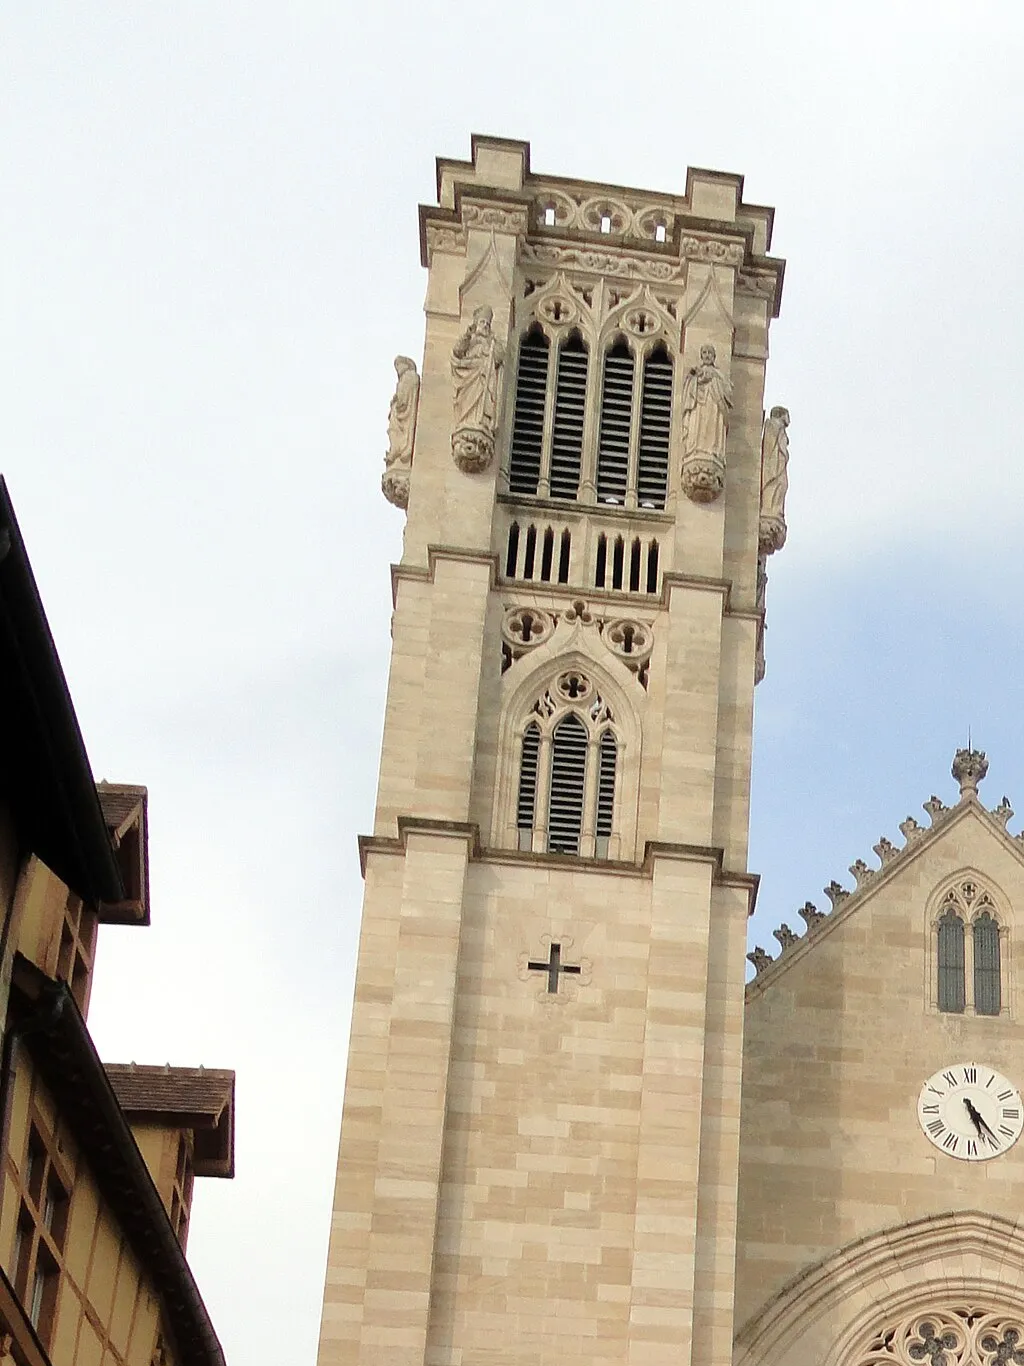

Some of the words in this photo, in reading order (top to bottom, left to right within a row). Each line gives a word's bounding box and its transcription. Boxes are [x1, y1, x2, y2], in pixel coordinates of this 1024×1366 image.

[942, 1071, 958, 1088] XI
[964, 1068, 977, 1084] XII
[986, 1075, 995, 1088] I
[928, 1087, 944, 1097] X
[997, 1090, 1013, 1101] II
[923, 1104, 939, 1114] IX
[1003, 1109, 1019, 1118] III
[926, 1119, 946, 1138] VIII
[998, 1125, 1014, 1140] IV
[943, 1133, 959, 1151] VII
[967, 1140, 978, 1156] VI
[987, 1137, 998, 1152] V
